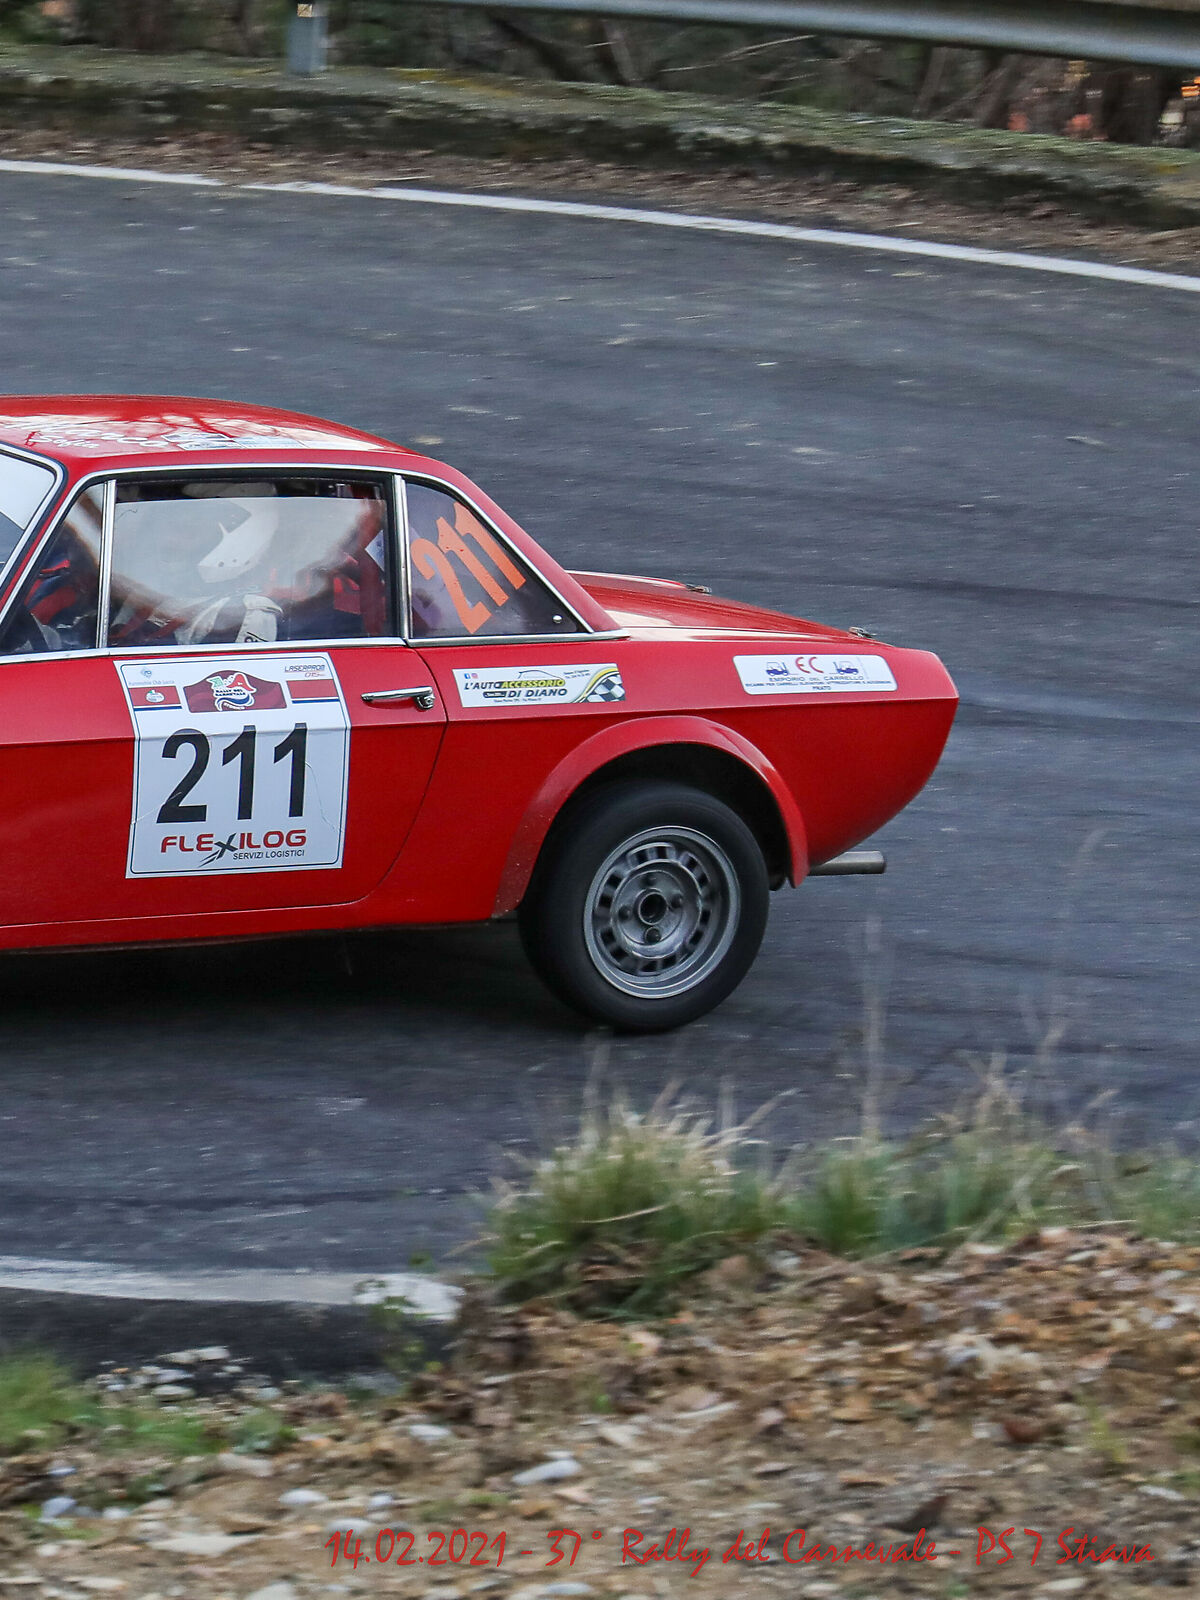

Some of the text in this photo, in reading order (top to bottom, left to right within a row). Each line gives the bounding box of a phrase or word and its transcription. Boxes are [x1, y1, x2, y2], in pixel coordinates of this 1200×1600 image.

[410, 501, 527, 634] 211
[507, 688, 568, 698] DI DIANO
[156, 722, 308, 824] 211
[160, 829, 307, 861] FLEXILOG
[233, 849, 305, 860] SERVIZI LOGISTICI
